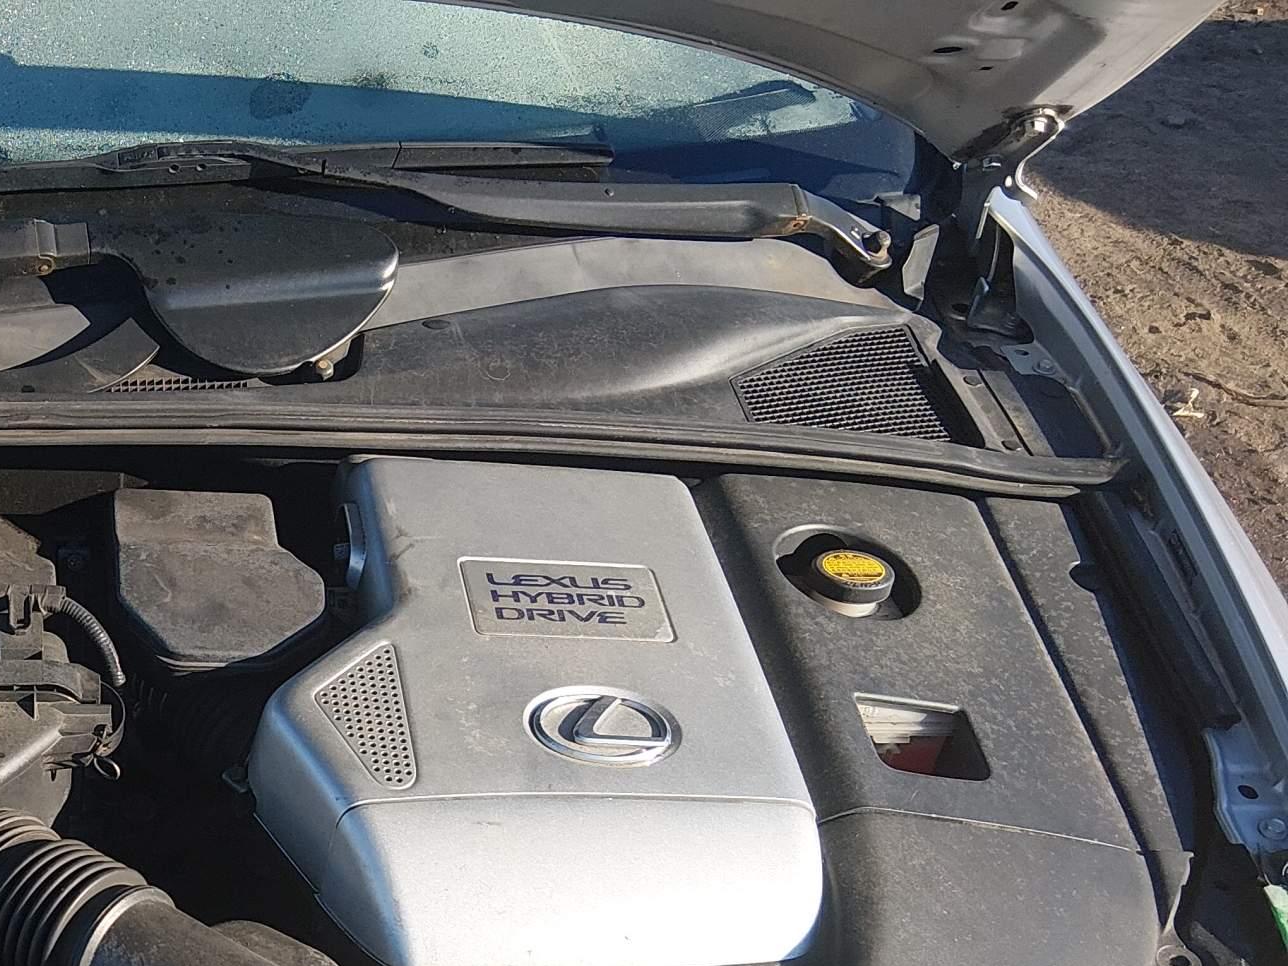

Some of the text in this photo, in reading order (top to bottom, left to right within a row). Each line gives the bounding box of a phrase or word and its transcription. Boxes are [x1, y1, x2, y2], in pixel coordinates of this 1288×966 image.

[486, 573, 632, 591] LEXUS
[490, 590, 646, 608] HYBRID
[495, 607, 627, 624] DRIVE
